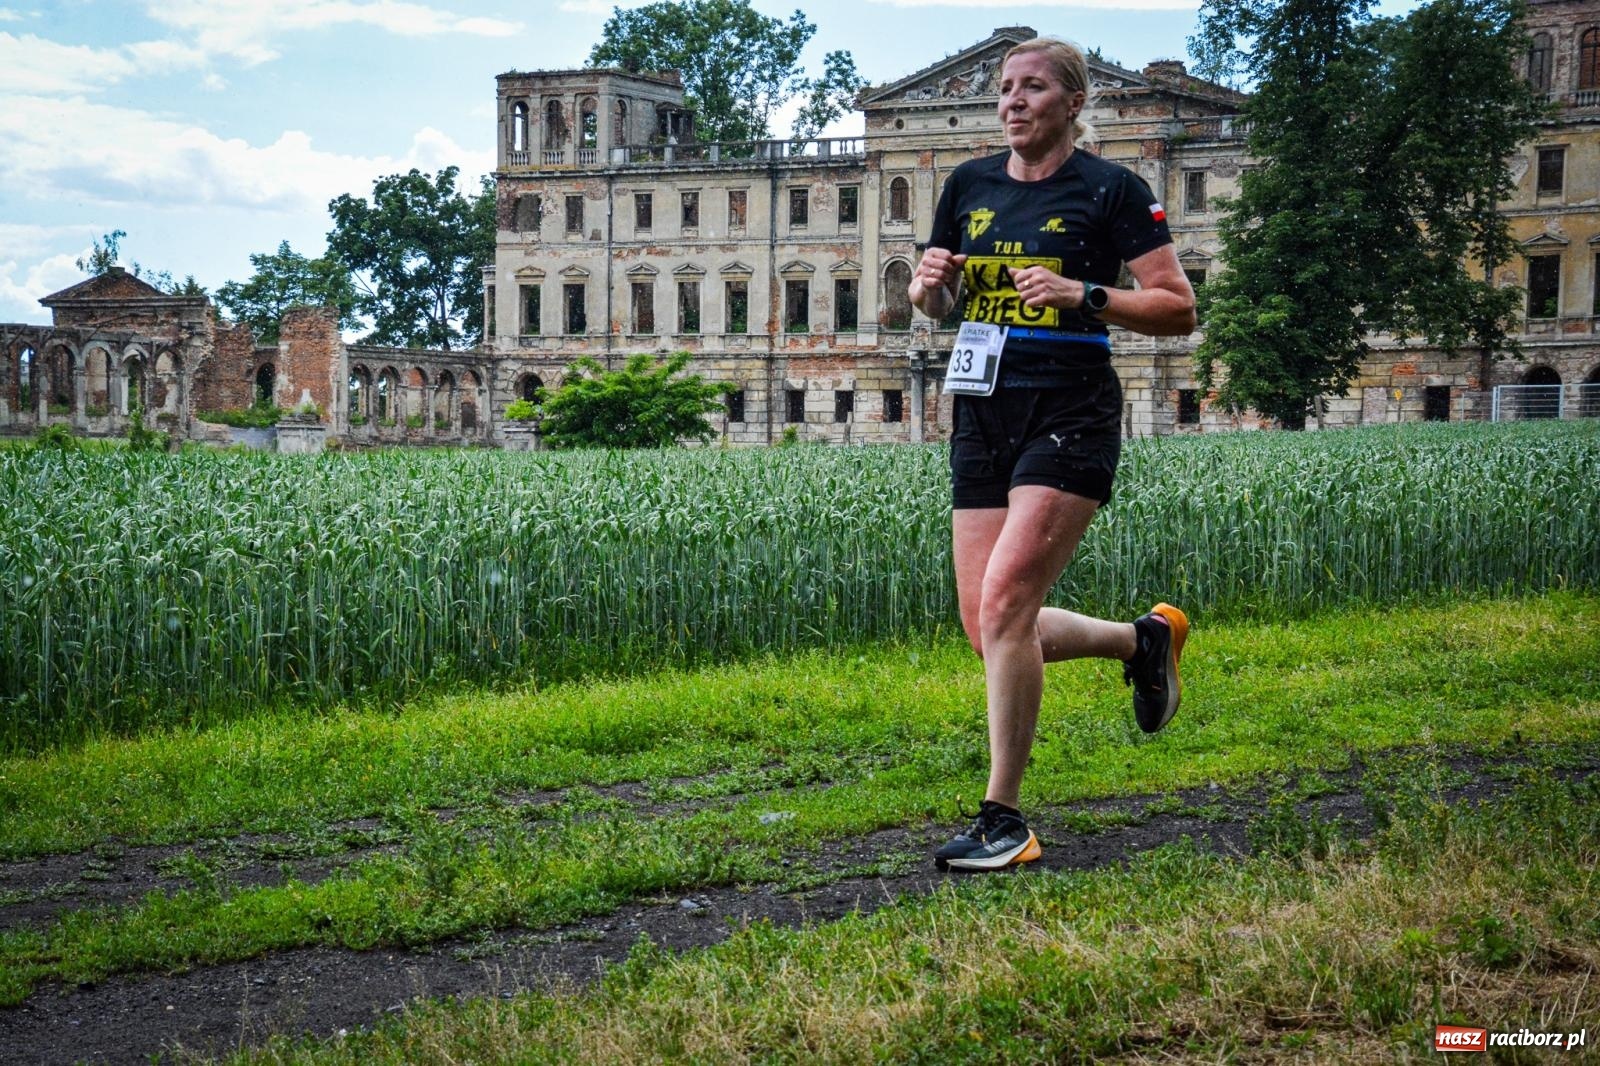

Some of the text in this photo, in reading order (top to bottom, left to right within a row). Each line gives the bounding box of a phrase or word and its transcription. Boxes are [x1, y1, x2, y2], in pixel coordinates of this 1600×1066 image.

[994, 241, 1024, 254] T.U.R.
[972, 263, 1045, 291] KA
[975, 295, 1046, 322] BIEG
